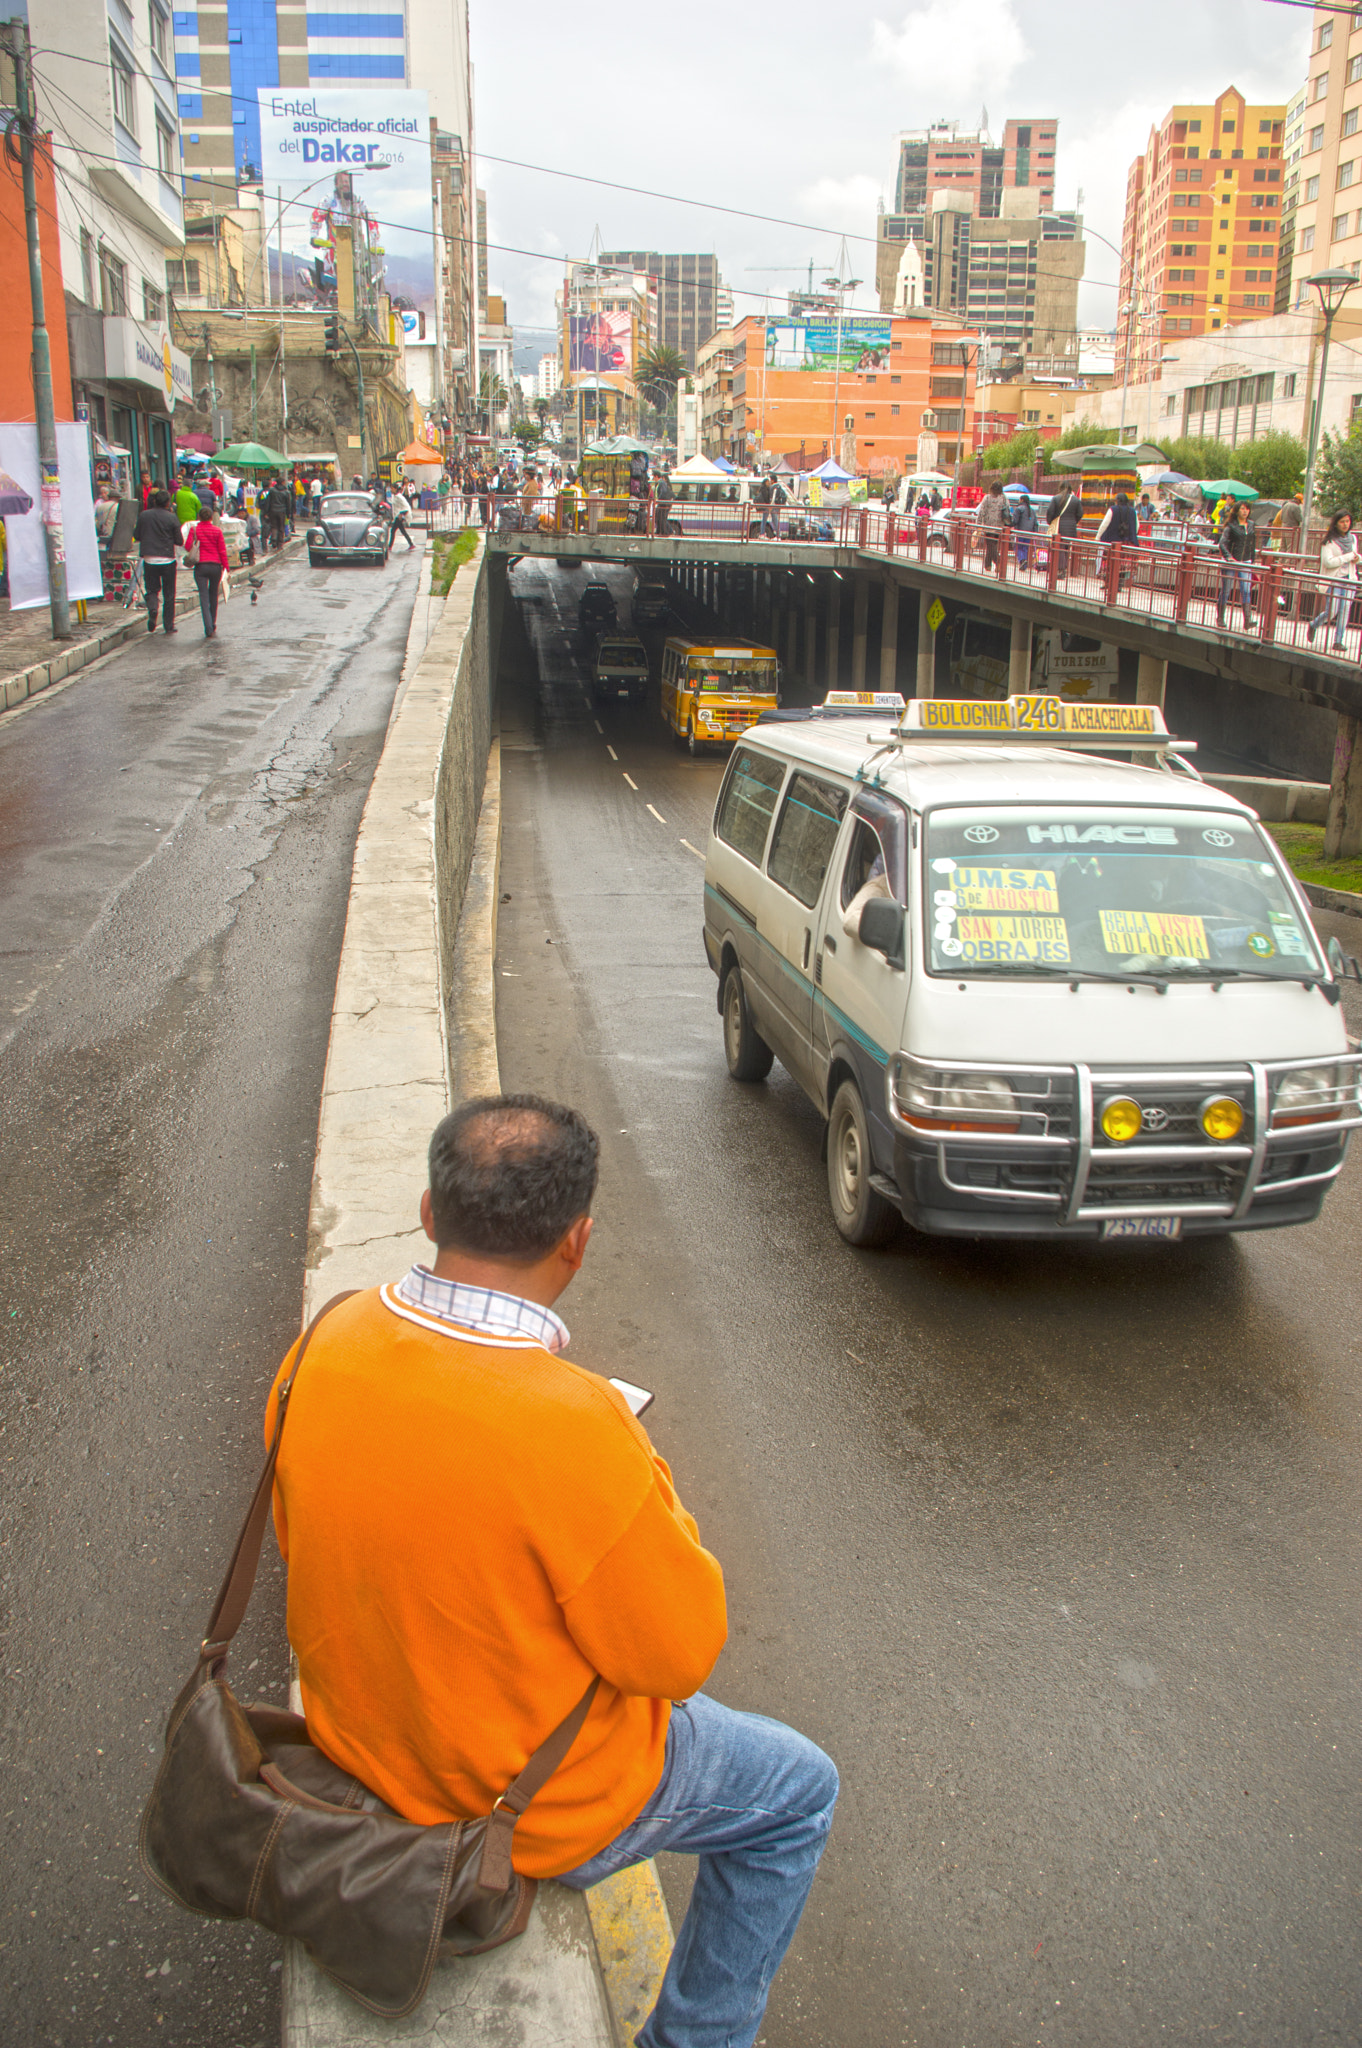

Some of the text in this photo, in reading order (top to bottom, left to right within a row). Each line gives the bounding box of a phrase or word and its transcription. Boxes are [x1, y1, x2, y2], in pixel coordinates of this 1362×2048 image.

[272, 97, 319, 117] Entel
[293, 118, 419, 135] auspiciador oficial
[279, 138, 404, 163] del Dakar 2016
[1053, 656, 1106, 667] TURISMO
[857, 693, 874, 704] 201
[926, 698, 1151, 732] BOLOGNIA 246 ACHACHICALA
[1026, 824, 1179, 845] HIACE
[955, 888, 1053, 912] 6 DE AGOSTO
[961, 917, 1065, 940] SAN JORGE
[1103, 911, 1202, 937] BELLA VISTA
[962, 940, 1069, 963] OBRAJES
[1106, 932, 1205, 959] BOLOGNIA
